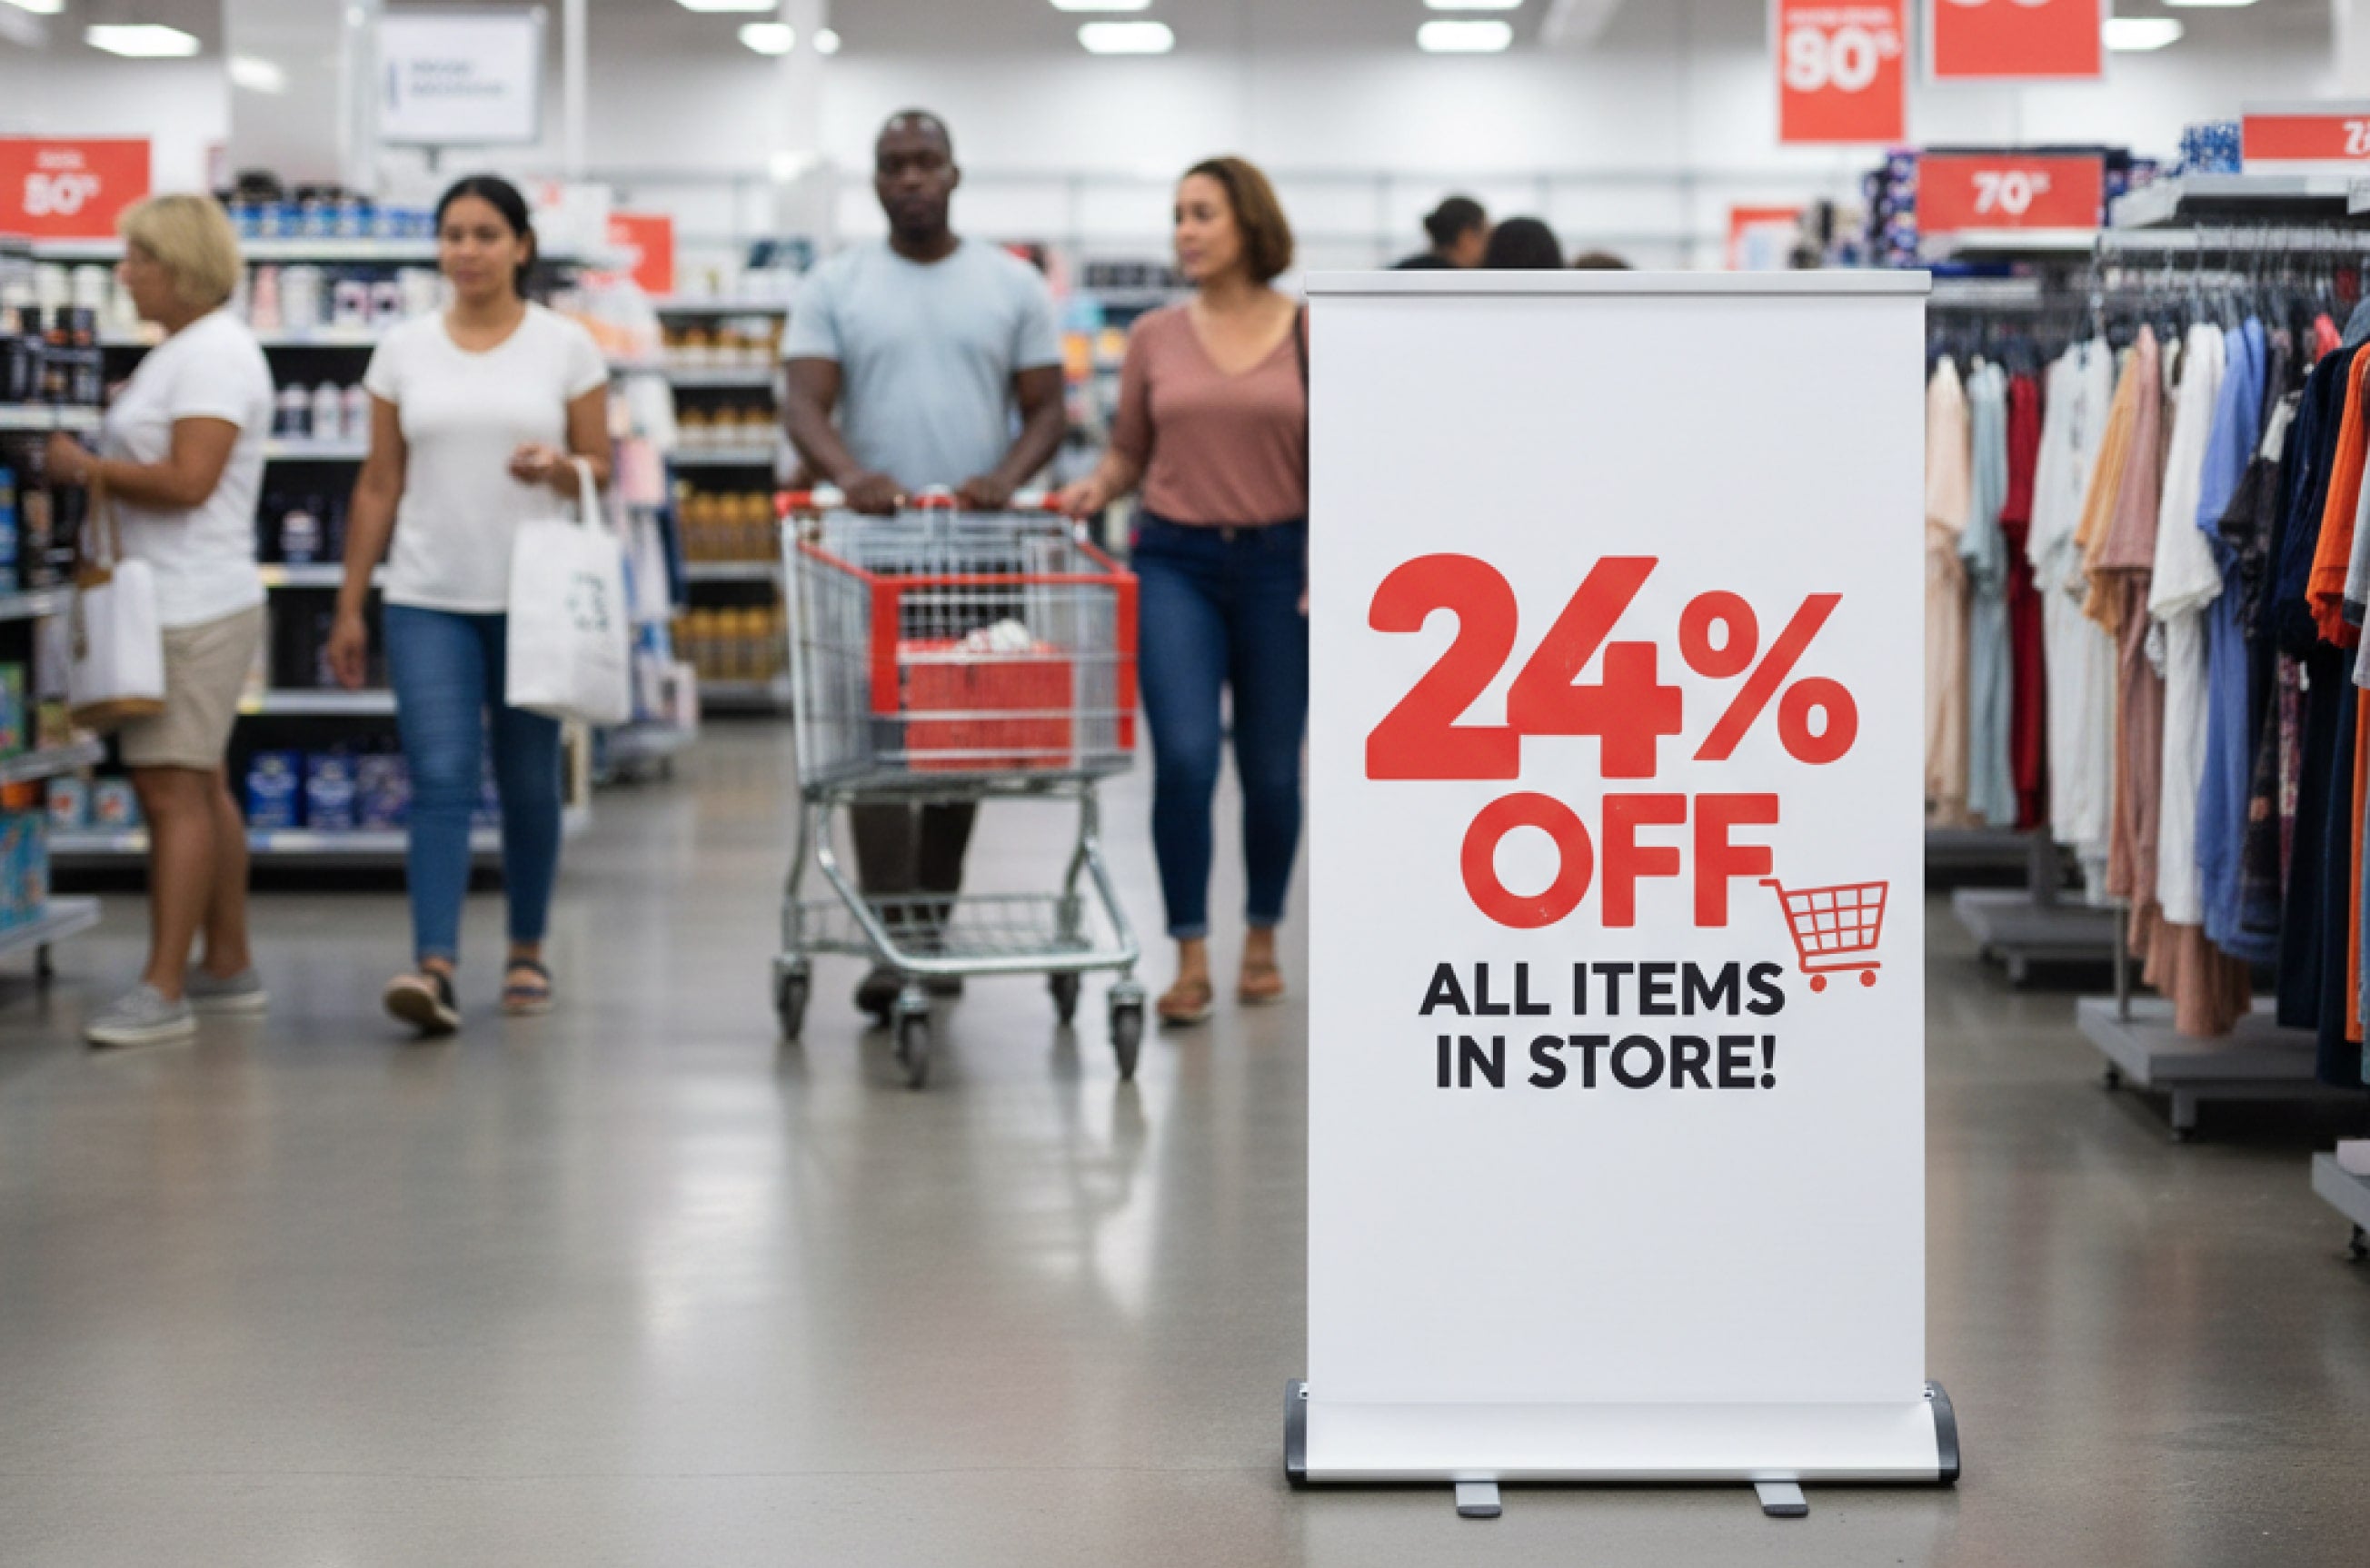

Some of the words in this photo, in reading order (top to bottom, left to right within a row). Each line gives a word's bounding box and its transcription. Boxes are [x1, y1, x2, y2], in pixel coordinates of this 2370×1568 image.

[1365, 552, 1858, 781] 24%
[1460, 791, 1778, 929] OFF
[1419, 962, 1550, 1016] ALL
[1574, 962, 1786, 1016] ITEMS
[1437, 1035, 1506, 1089] IN
[1528, 1035, 1777, 1090] STORE!
